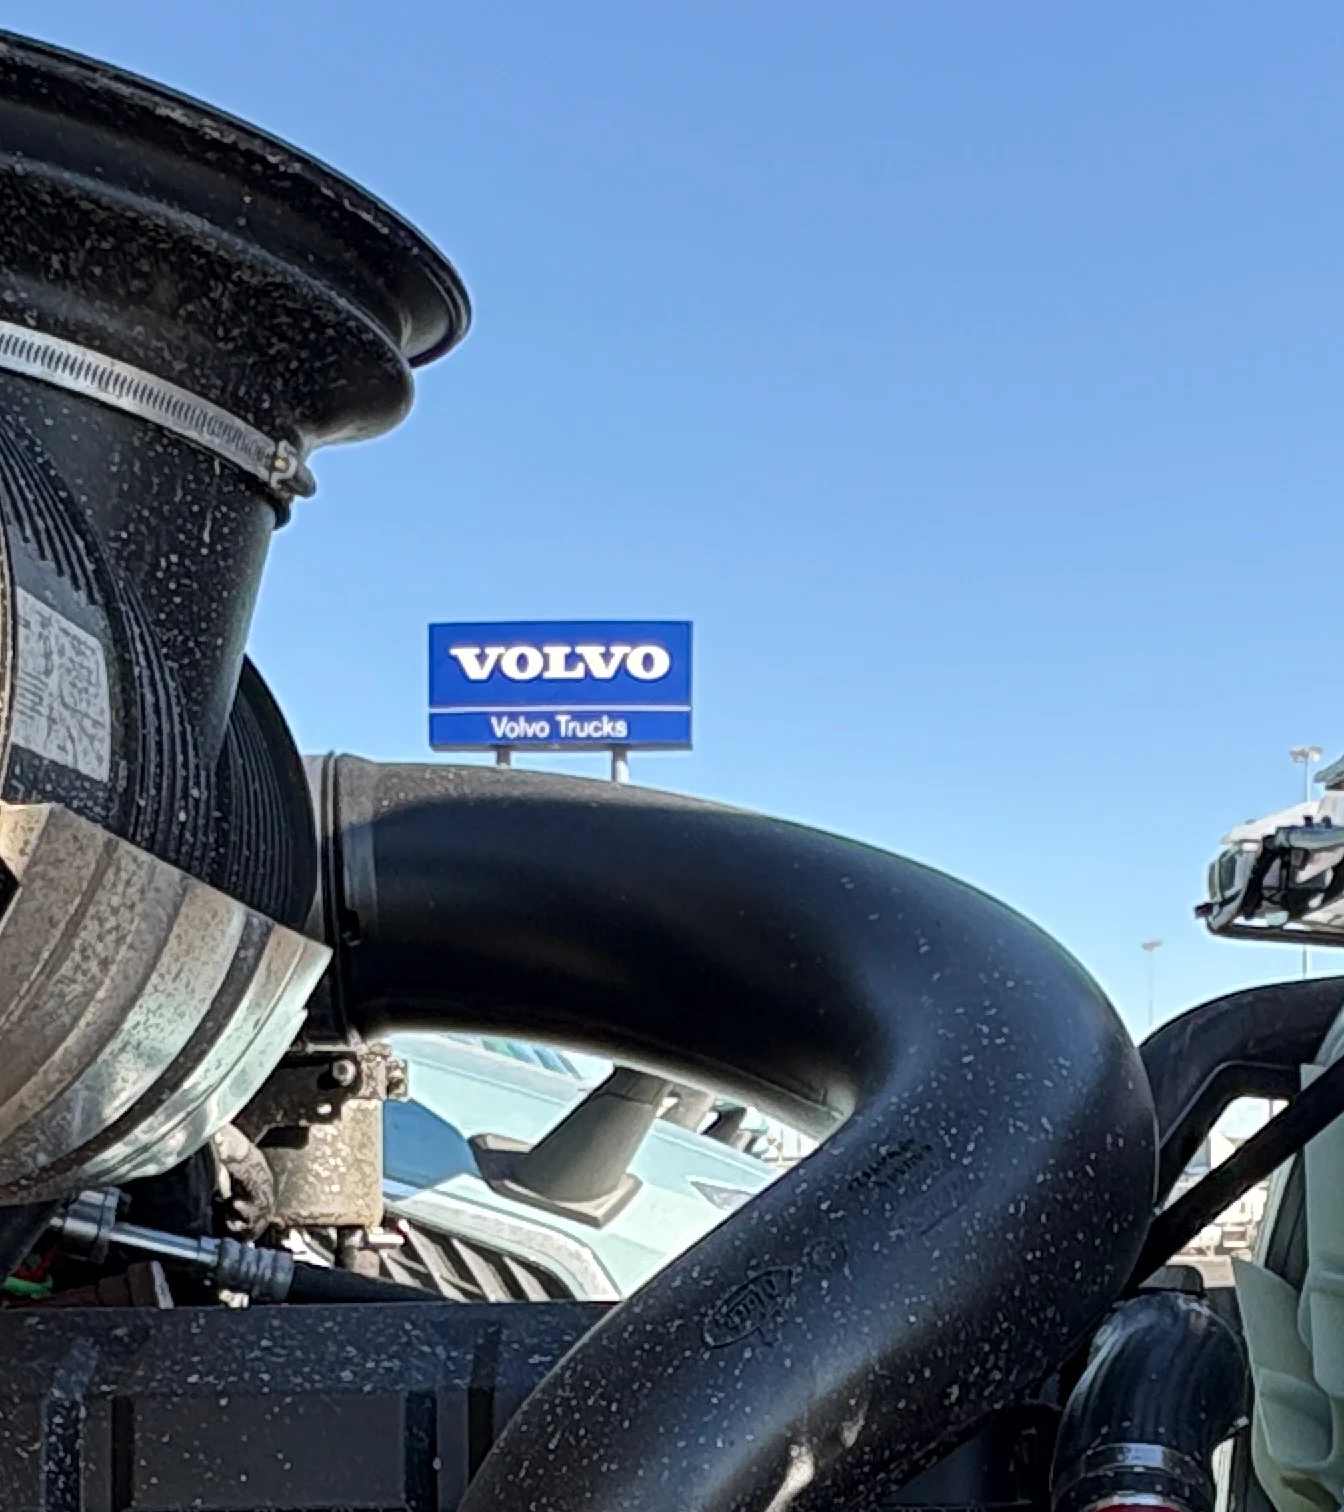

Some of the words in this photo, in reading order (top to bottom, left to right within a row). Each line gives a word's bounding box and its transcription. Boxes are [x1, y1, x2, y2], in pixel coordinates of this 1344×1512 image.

[449, 645, 671, 681] VOLVO
[490, 715, 551, 739] Volvo
[555, 714, 628, 739] Trucks
